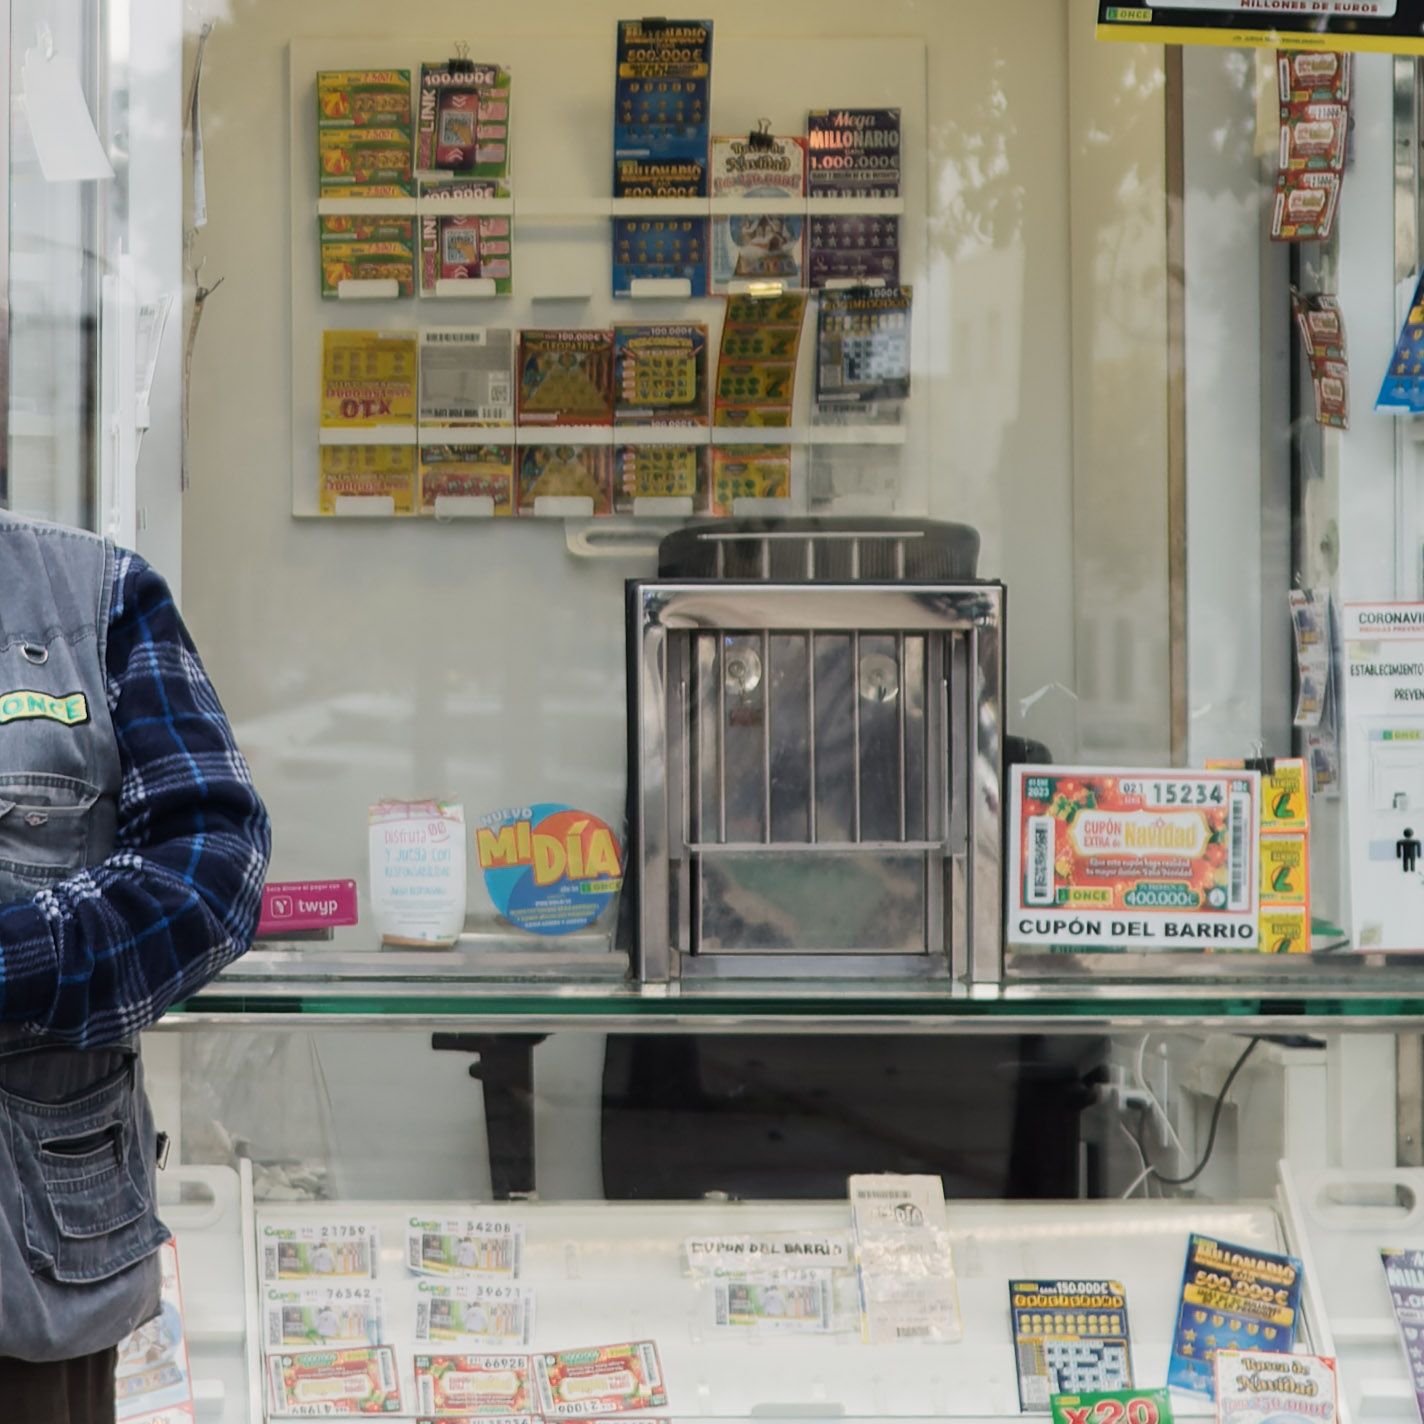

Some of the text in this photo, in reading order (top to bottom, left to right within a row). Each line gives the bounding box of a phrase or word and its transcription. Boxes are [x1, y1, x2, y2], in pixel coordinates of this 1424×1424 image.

[1312, 1, 1329, 10] DE
[1334, 2, 1378, 12] EUROS
[1119, 10, 1152, 21] ONCE
[420, 89, 436, 133] LINK
[834, 111, 876, 128] Mega
[809, 130, 899, 149] MILLONARIO
[810, 156, 898, 169] 1.000.000€
[1350, 663, 1424, 676] ESTABLECIMIENTO
[3, 693, 81, 720] ONCE
[1027, 787, 1050, 797] 2023
[1153, 784, 1224, 804] 15234
[481, 808, 533, 826] NUEVO
[1084, 818, 1121, 835] CUPÓN
[1125, 819, 1196, 849] Navidad
[1083, 837, 1110, 847] EXTRA
[476, 819, 623, 888] MI DÍA
[1073, 890, 1109, 901] ONCE
[1126, 891, 1198, 905] 400.000€
[298, 899, 338, 916] twyp
[1018, 916, 1102, 936] CUPÓN
[1111, 921, 1156, 937] DEL
[1164, 922, 1254, 939] BARRIO
[321, 1226, 366, 1236] 21759
[1056, 1281, 1109, 1295] 150.000€
[1195, 1270, 1289, 1307] 500.000€
